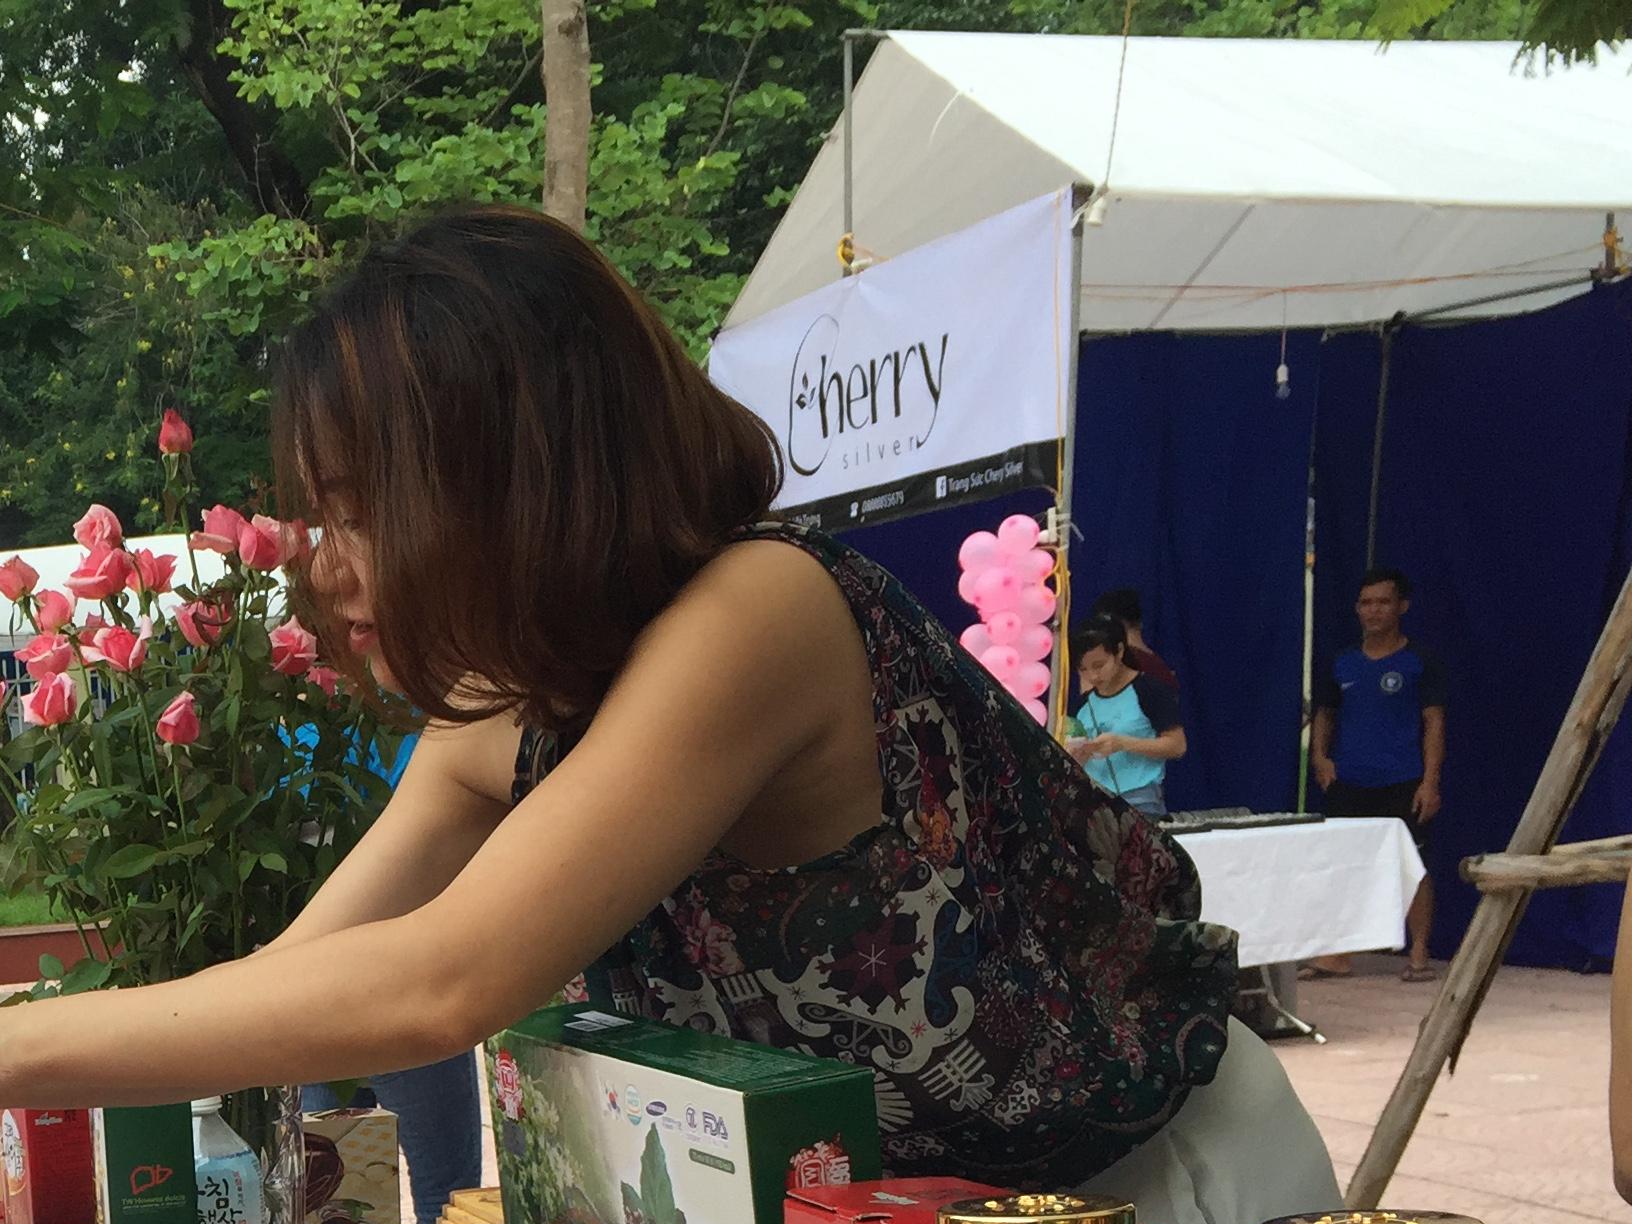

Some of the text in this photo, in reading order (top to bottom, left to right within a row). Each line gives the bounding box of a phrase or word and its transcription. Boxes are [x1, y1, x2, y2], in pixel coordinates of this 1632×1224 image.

[788, 313, 949, 477] Cherry
[842, 437, 917, 470] silver
[701, 1110, 729, 1141] FDA
[197, 1175, 230, 1209] 침
